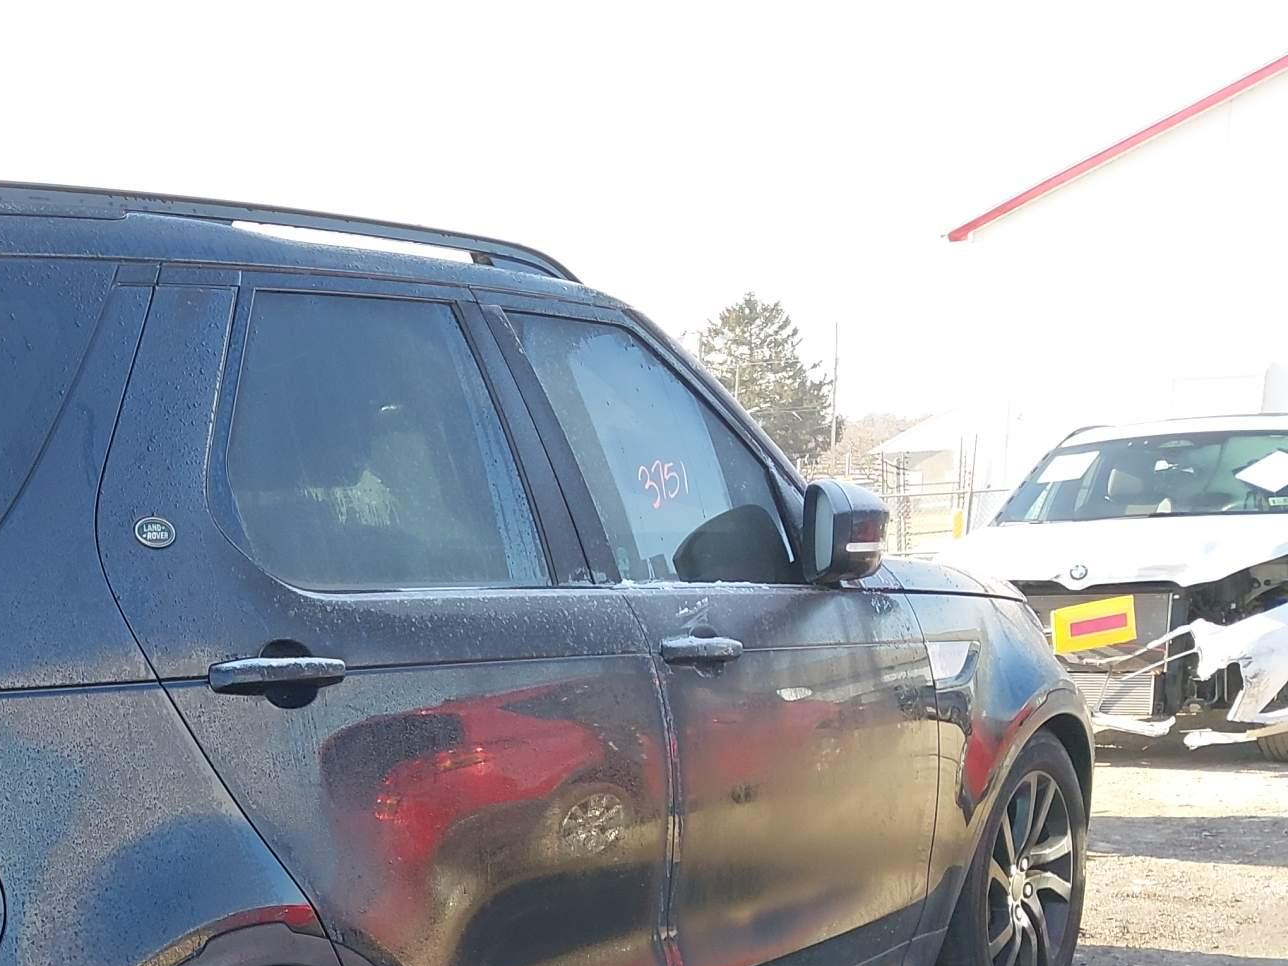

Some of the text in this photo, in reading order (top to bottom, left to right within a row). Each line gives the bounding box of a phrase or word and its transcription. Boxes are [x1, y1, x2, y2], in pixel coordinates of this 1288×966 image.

[637, 459, 689, 509] 3751
[143, 523, 162, 532] LAND
[147, 531, 169, 540] ROVER
